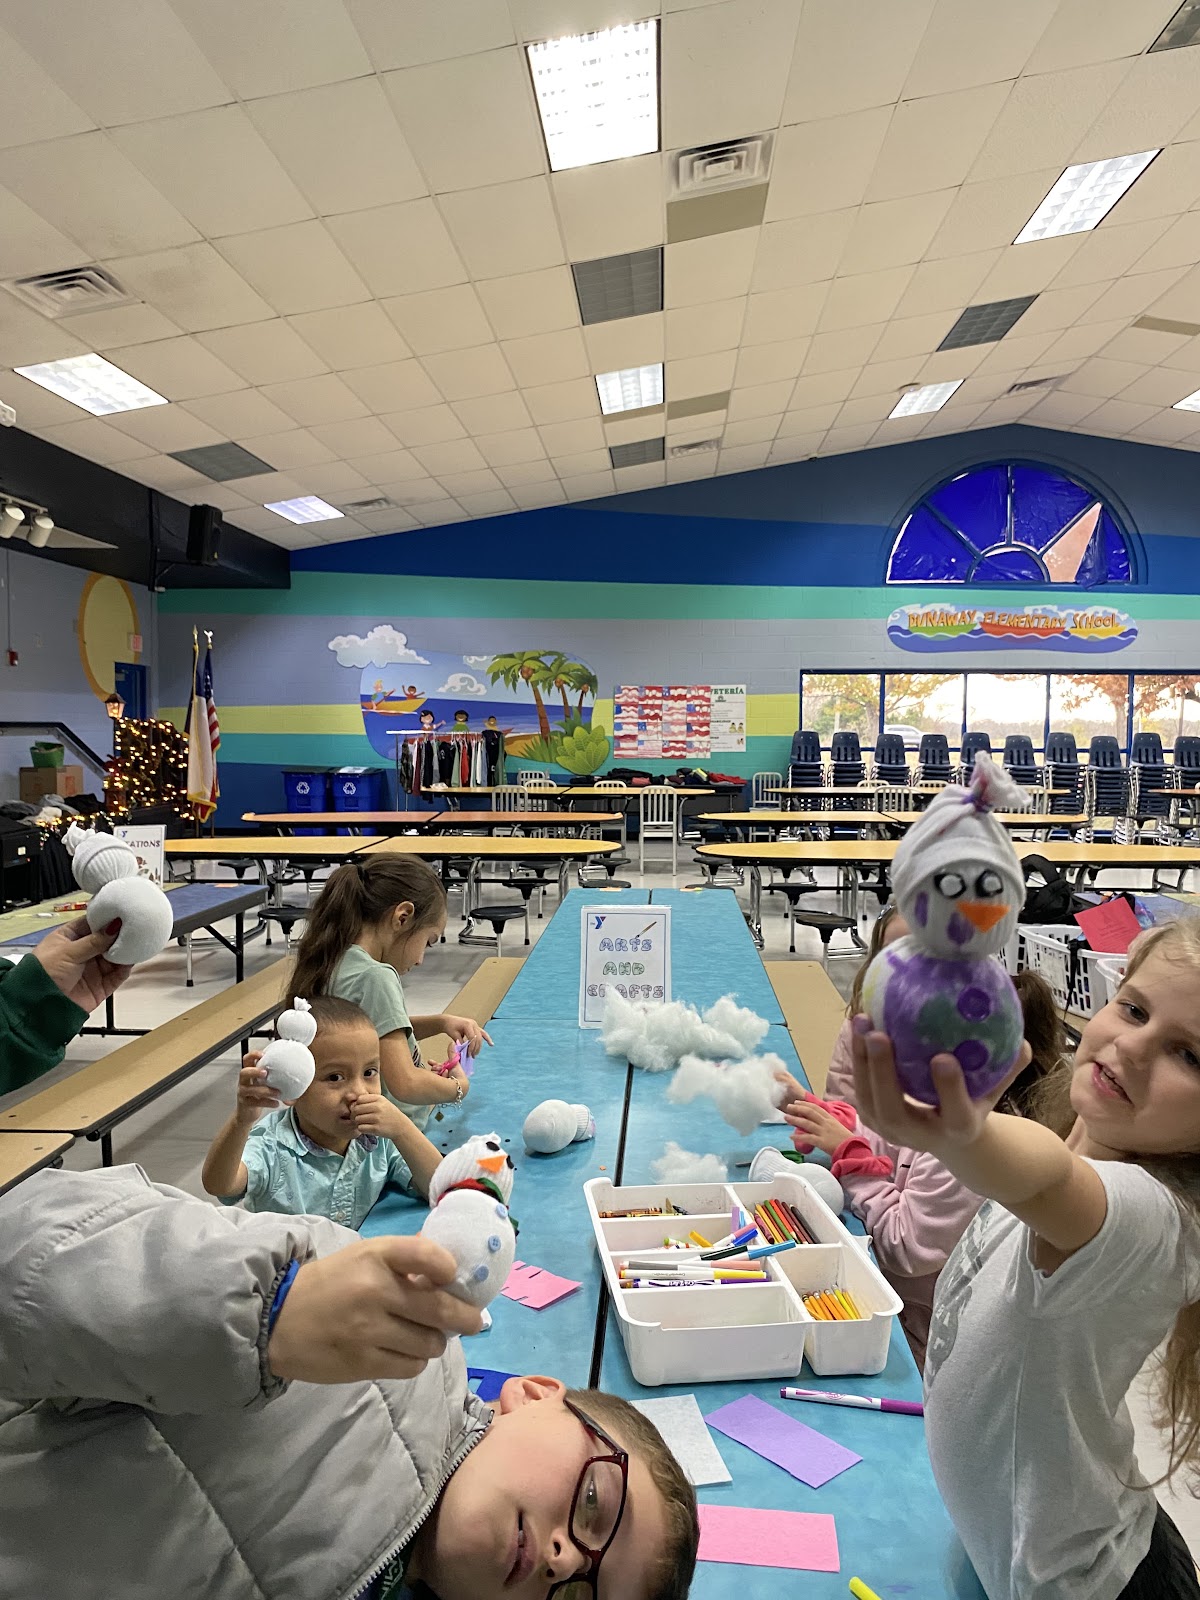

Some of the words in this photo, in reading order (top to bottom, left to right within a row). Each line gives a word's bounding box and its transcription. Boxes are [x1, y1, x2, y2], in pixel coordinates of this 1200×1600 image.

[908, 609, 977, 628] DUNAWAY
[983, 611, 1067, 629] ELEMENTARY
[1071, 612, 1120, 629] SCHOOL
[599, 937, 653, 952] ARTS
[602, 961, 645, 976] AND
